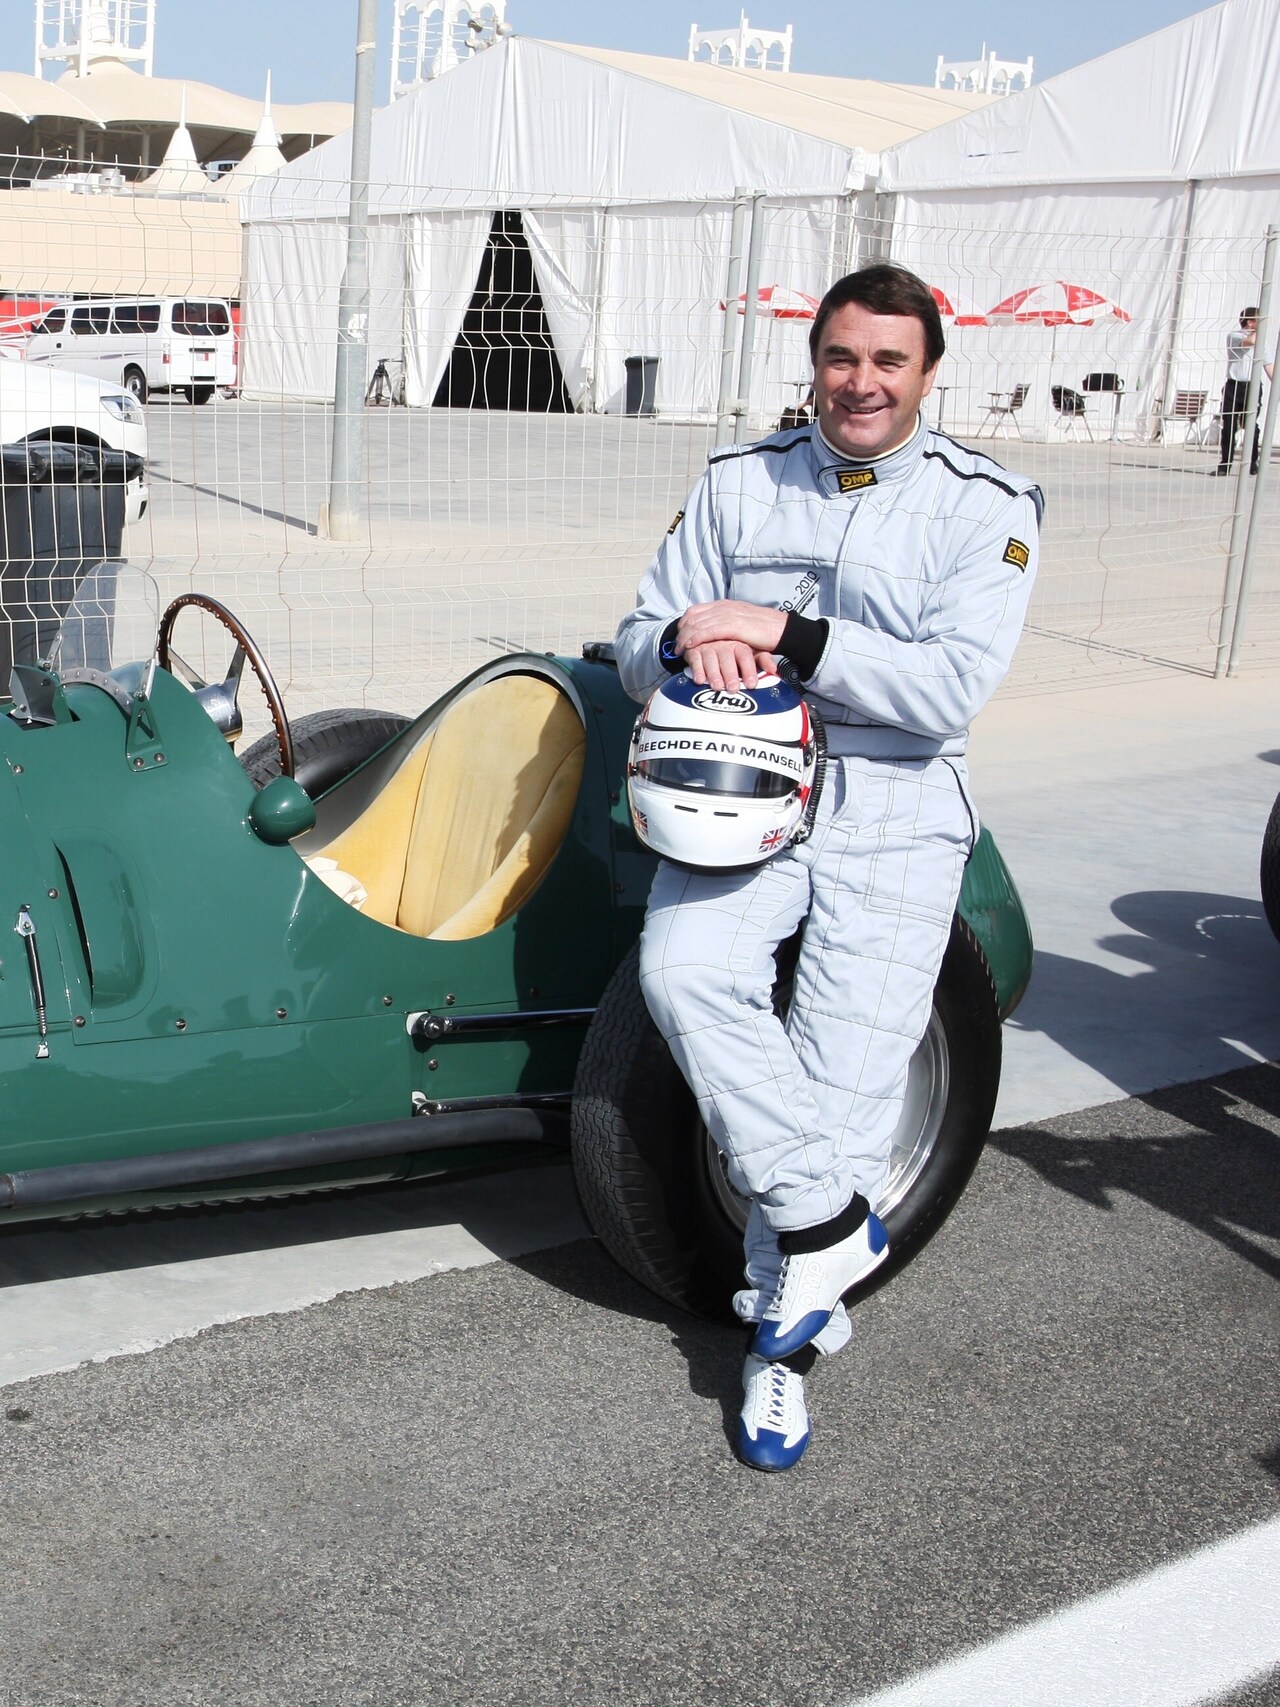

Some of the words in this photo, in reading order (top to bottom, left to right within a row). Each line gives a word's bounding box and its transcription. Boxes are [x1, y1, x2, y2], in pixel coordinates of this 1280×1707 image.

[840, 473, 873, 486] OMP
[794, 570, 818, 596] 2010
[696, 690, 748, 709] Arai
[639, 740, 735, 755] BEECHDEAN
[739, 746, 802, 773] MANSELL
